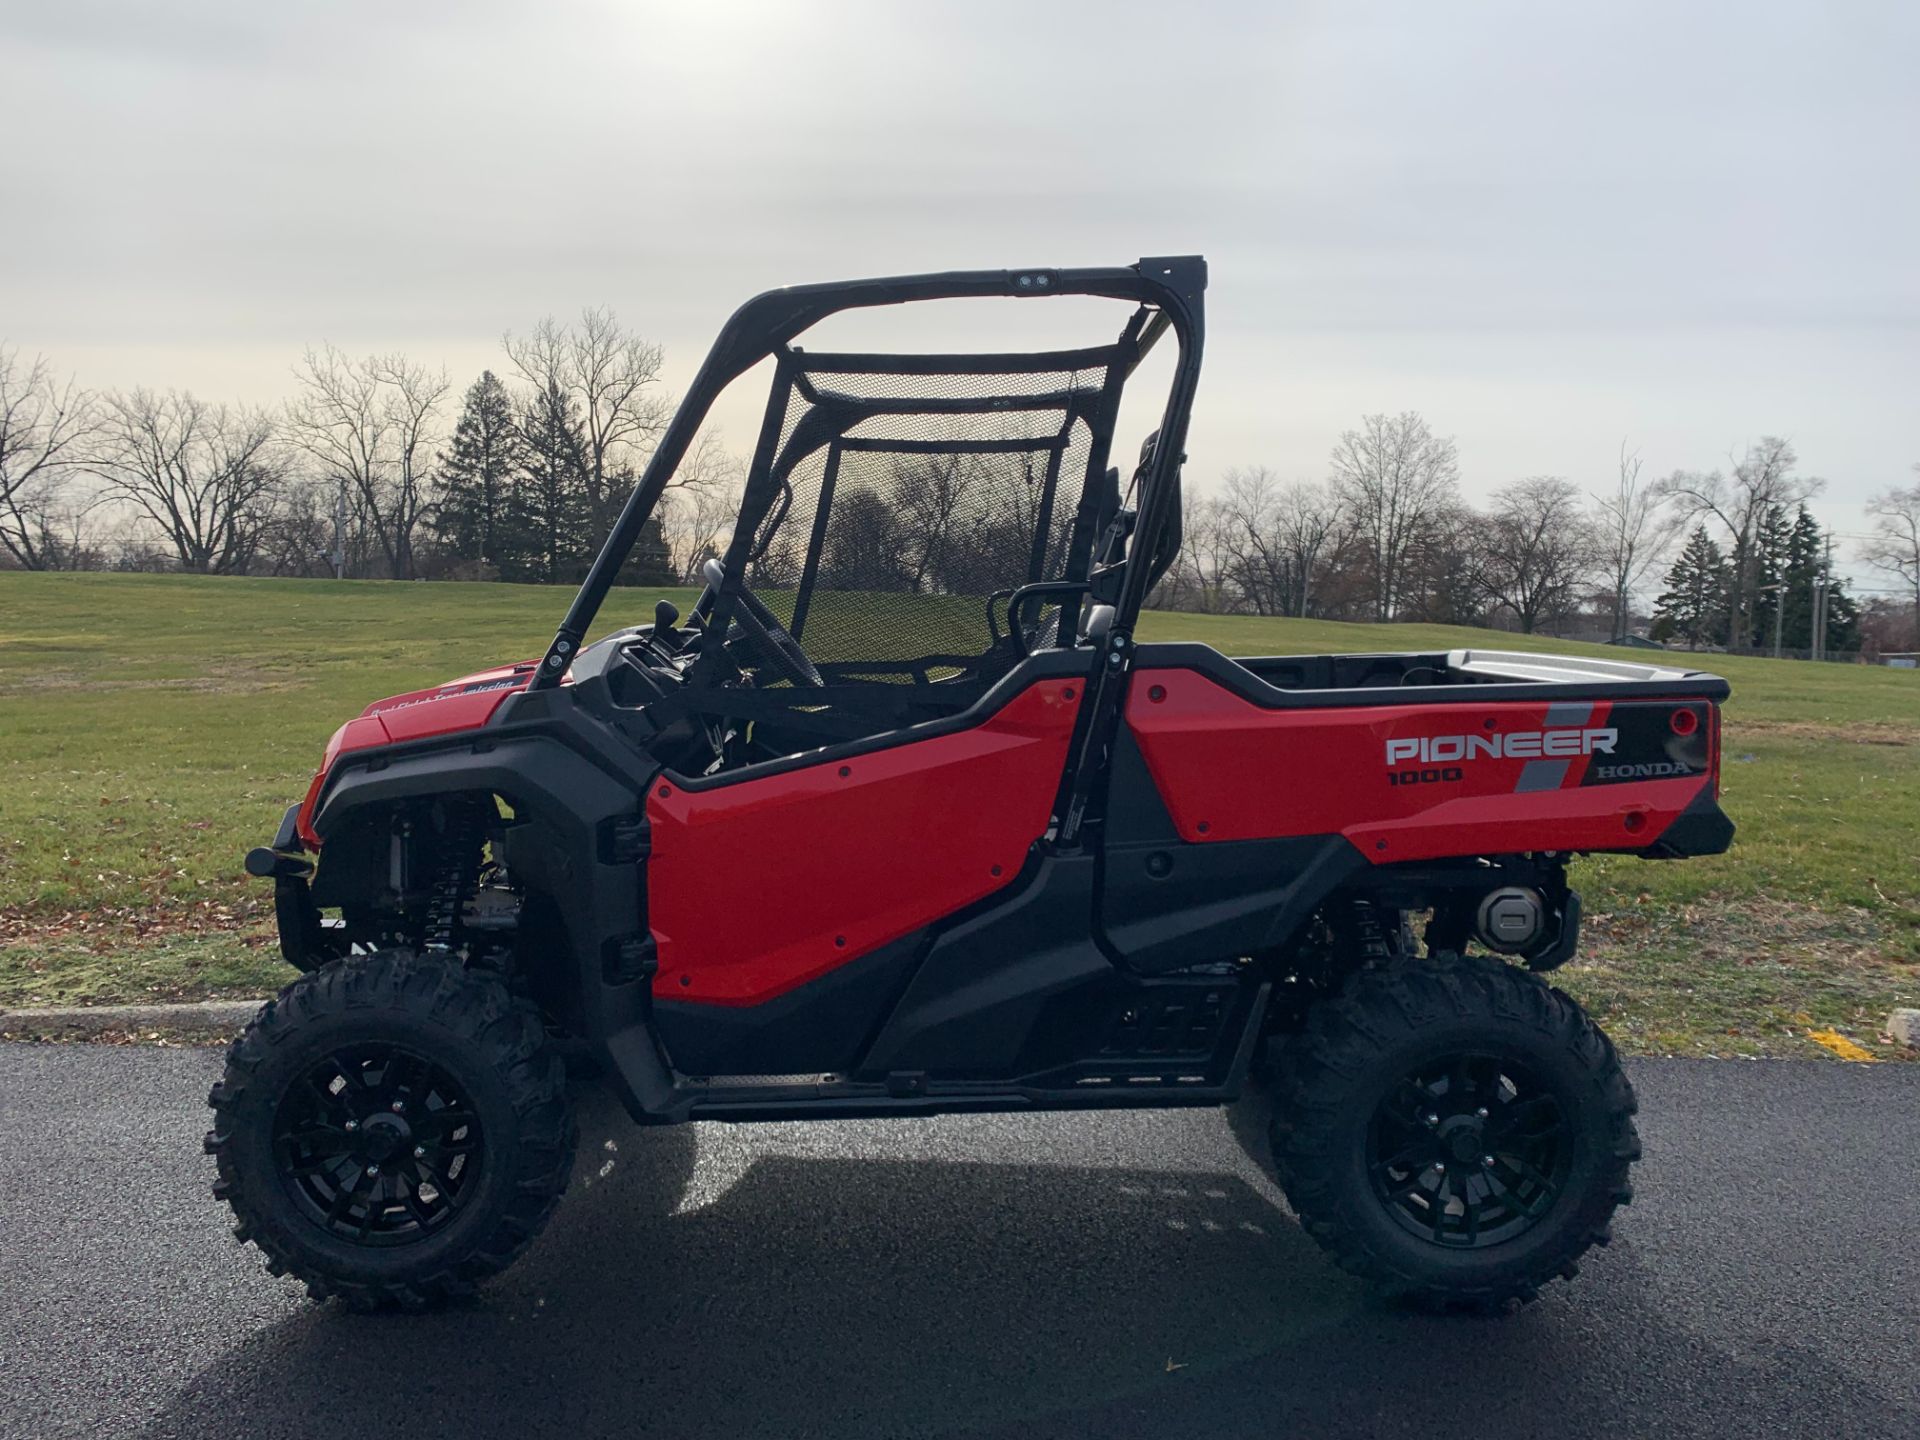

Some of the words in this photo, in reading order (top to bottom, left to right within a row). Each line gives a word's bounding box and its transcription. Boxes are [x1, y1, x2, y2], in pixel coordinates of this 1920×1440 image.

[1386, 727, 1618, 765] PIONEER
[1387, 768, 1463, 786] 1000
[1597, 761, 1693, 779] HONDA
